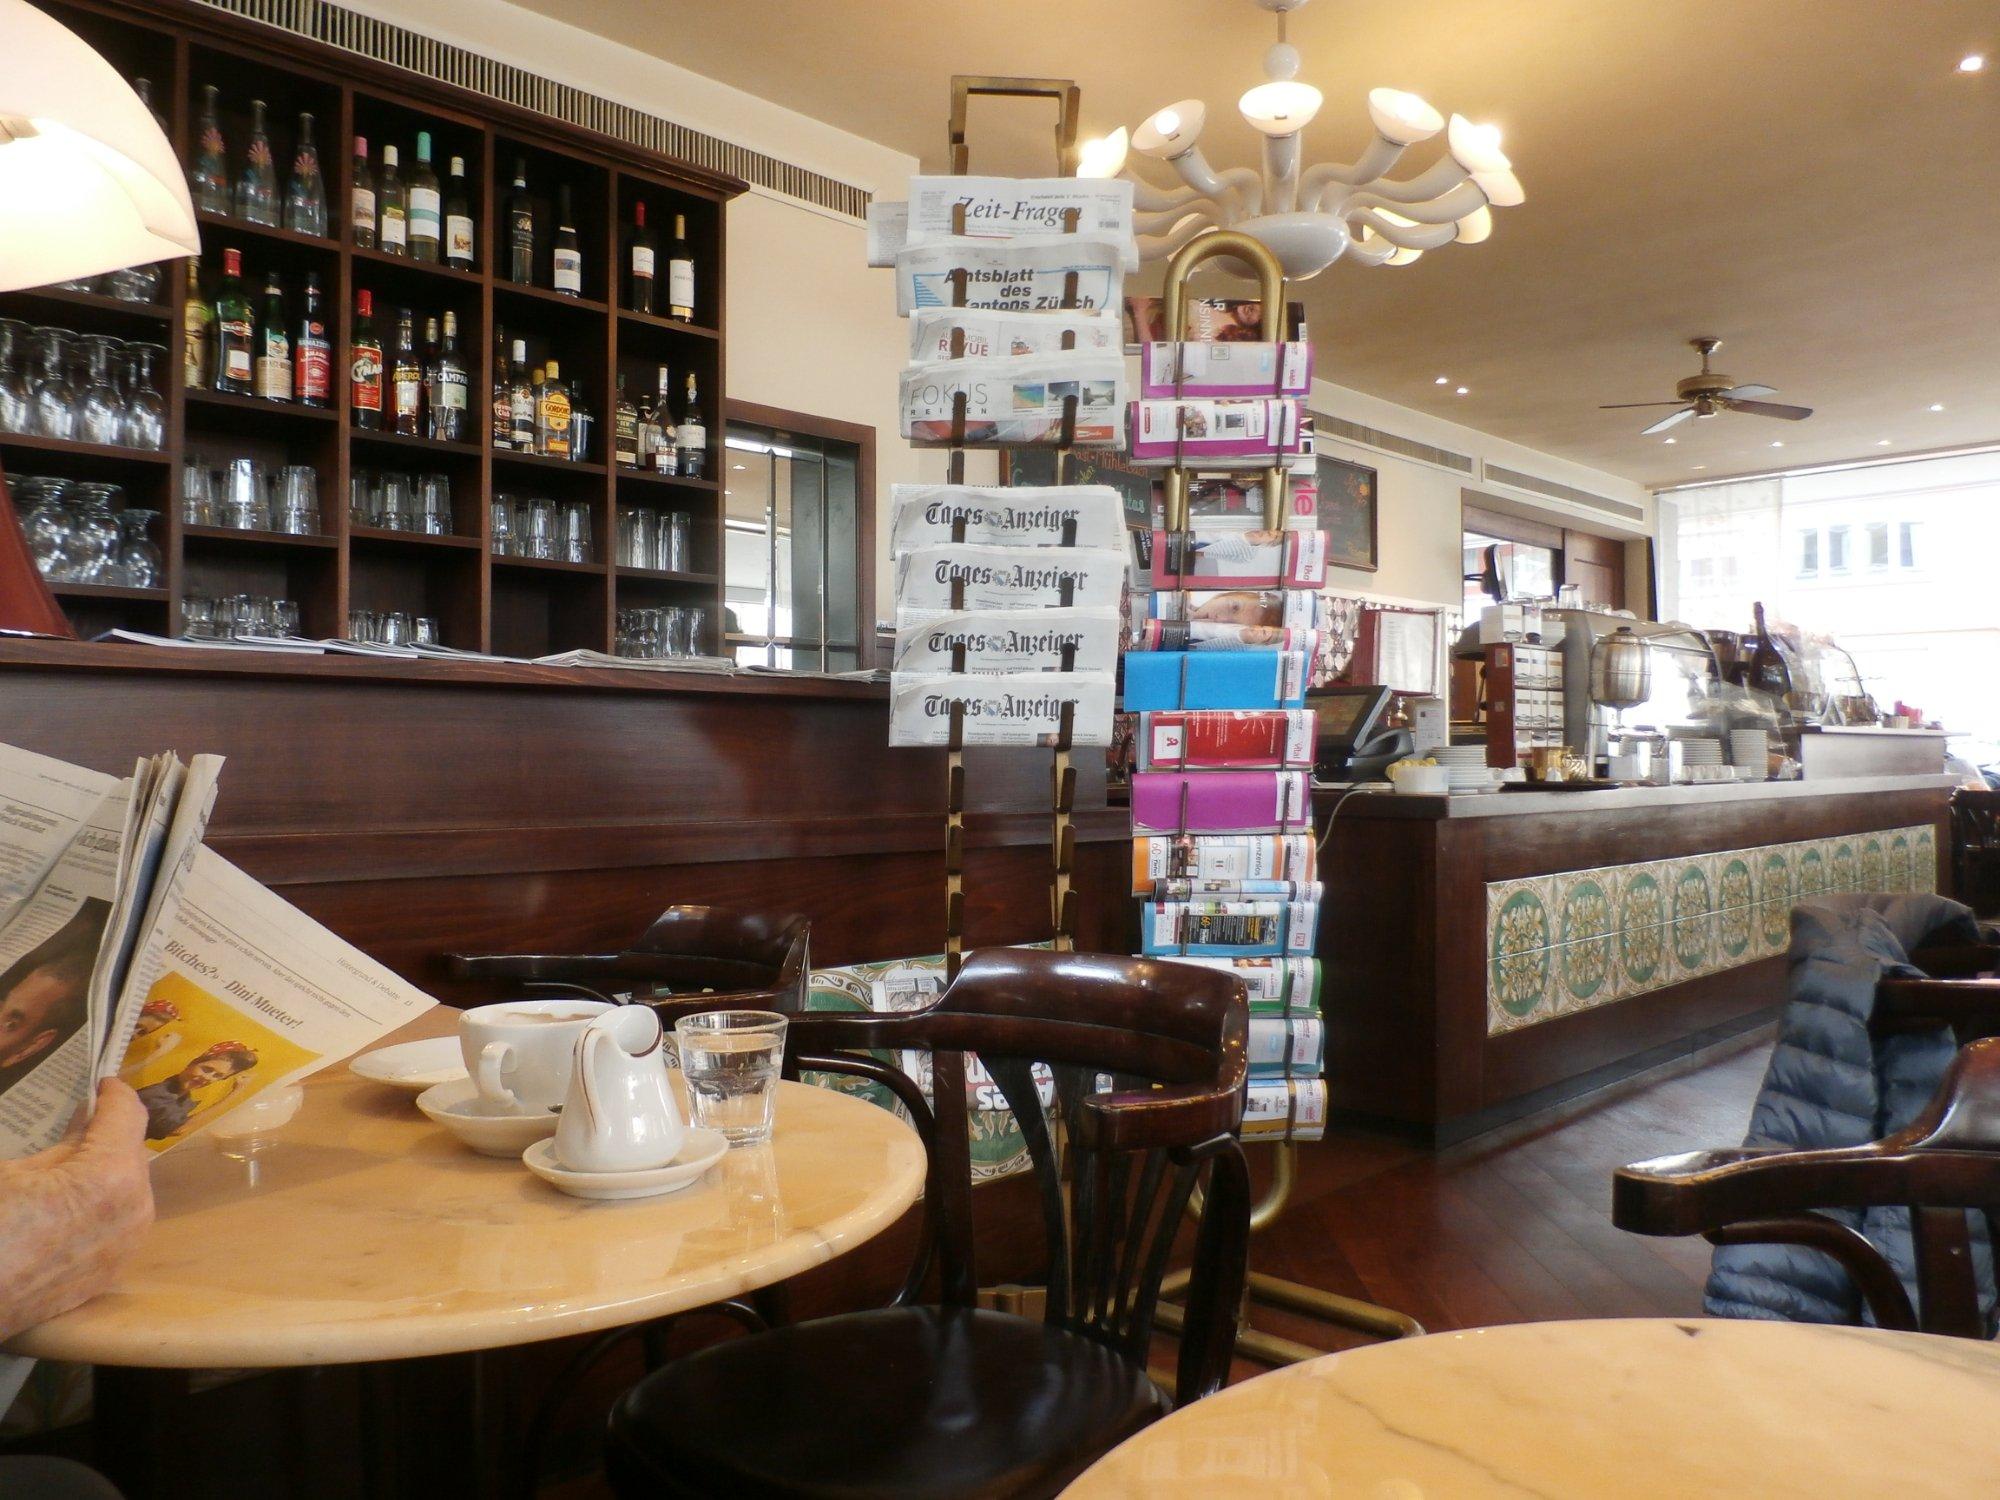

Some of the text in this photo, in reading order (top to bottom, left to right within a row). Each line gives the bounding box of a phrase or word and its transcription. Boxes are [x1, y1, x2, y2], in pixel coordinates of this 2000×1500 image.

[958, 195, 1082, 227] Zeit-Frage
[1000, 284, 1031, 298] des
[1034, 296, 1094, 311] Züch
[941, 332, 989, 345] AUOBIL
[938, 339, 989, 357] RUE
[910, 382, 988, 406] FOKUS
[545, 403, 571, 413] GORDON
[910, 407, 987, 416] REIEN
[924, 693, 1080, 722] Taes Anzeig
[223, 977, 258, 1006] Dini
[251, 993, 304, 1032] Mueter!
